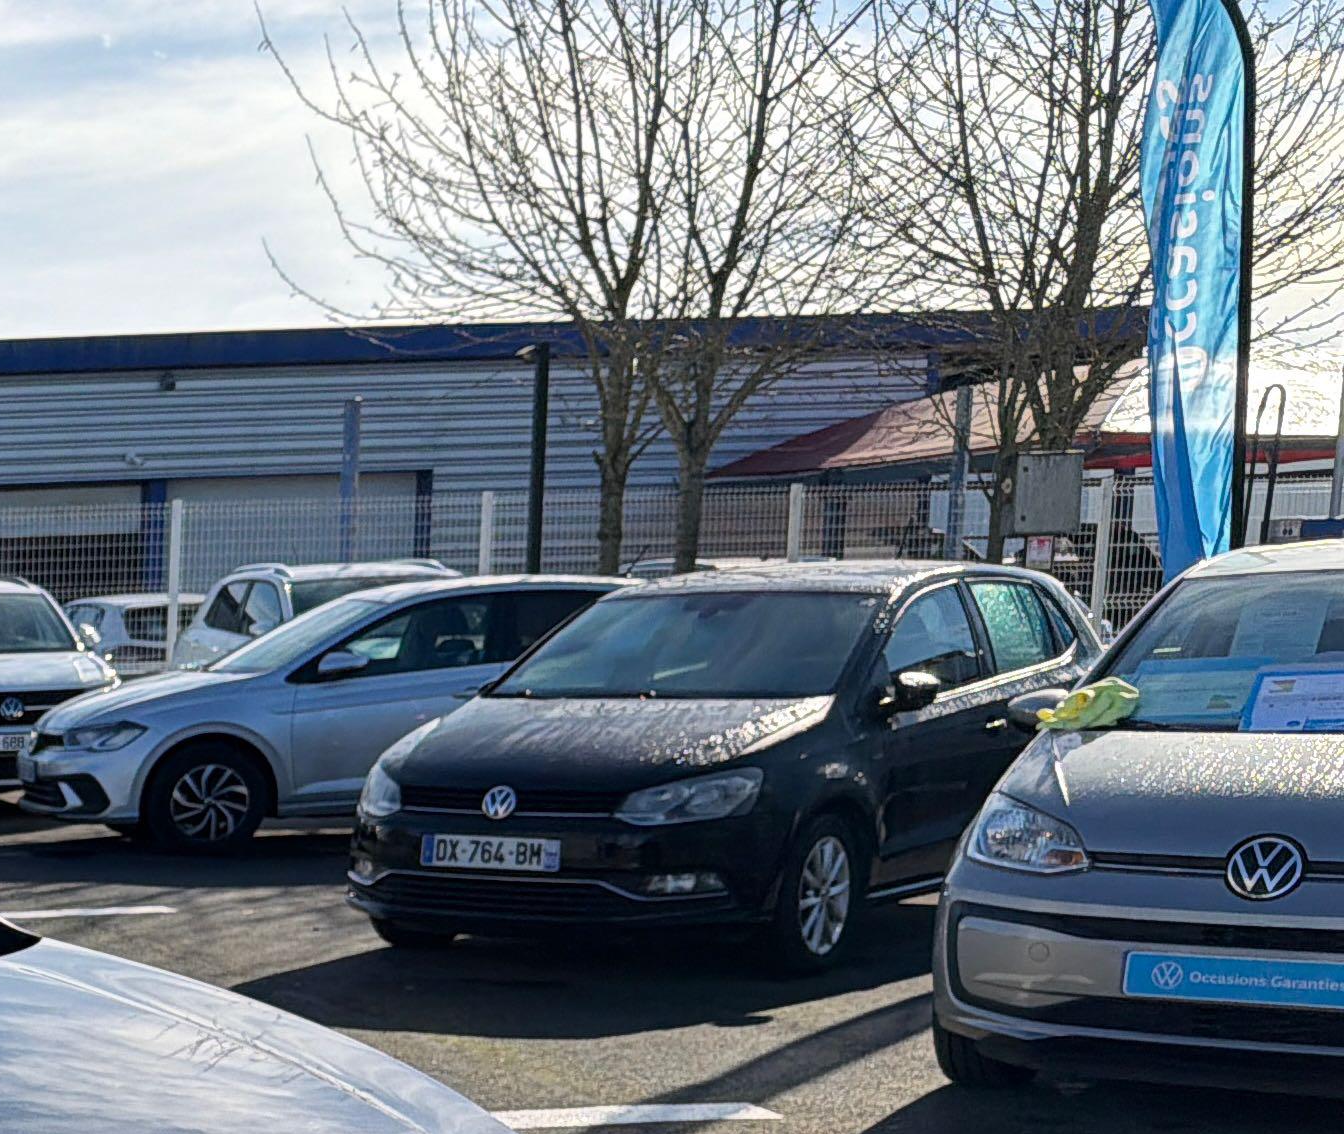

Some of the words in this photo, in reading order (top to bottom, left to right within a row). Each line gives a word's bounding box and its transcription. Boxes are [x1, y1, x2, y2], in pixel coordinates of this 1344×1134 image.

[435, 837, 543, 866] DX-764-BM
[1189, 971, 1268, 988] Occasions
[1270, 975, 1344, 992] Garanties
